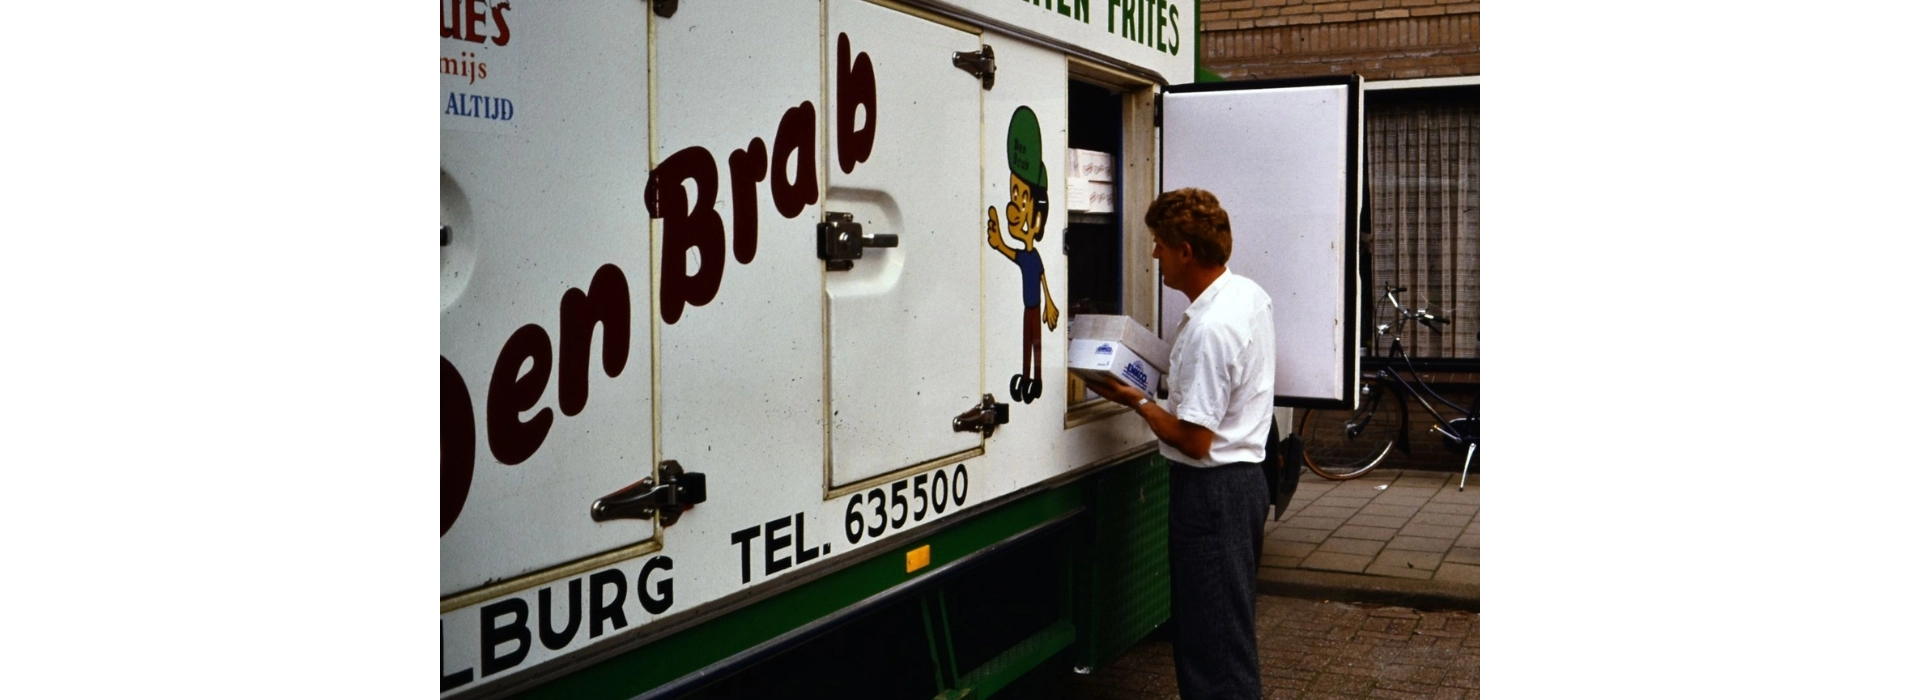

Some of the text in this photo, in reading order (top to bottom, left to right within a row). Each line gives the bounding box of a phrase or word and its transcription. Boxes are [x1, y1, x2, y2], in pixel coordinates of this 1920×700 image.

[1108, 0, 1180, 56] FRITES
[445, 92, 514, 121] ALTIJD
[645, 32, 877, 325] Brab
[731, 511, 831, 584] TEL.
[845, 463, 968, 544] 635500
